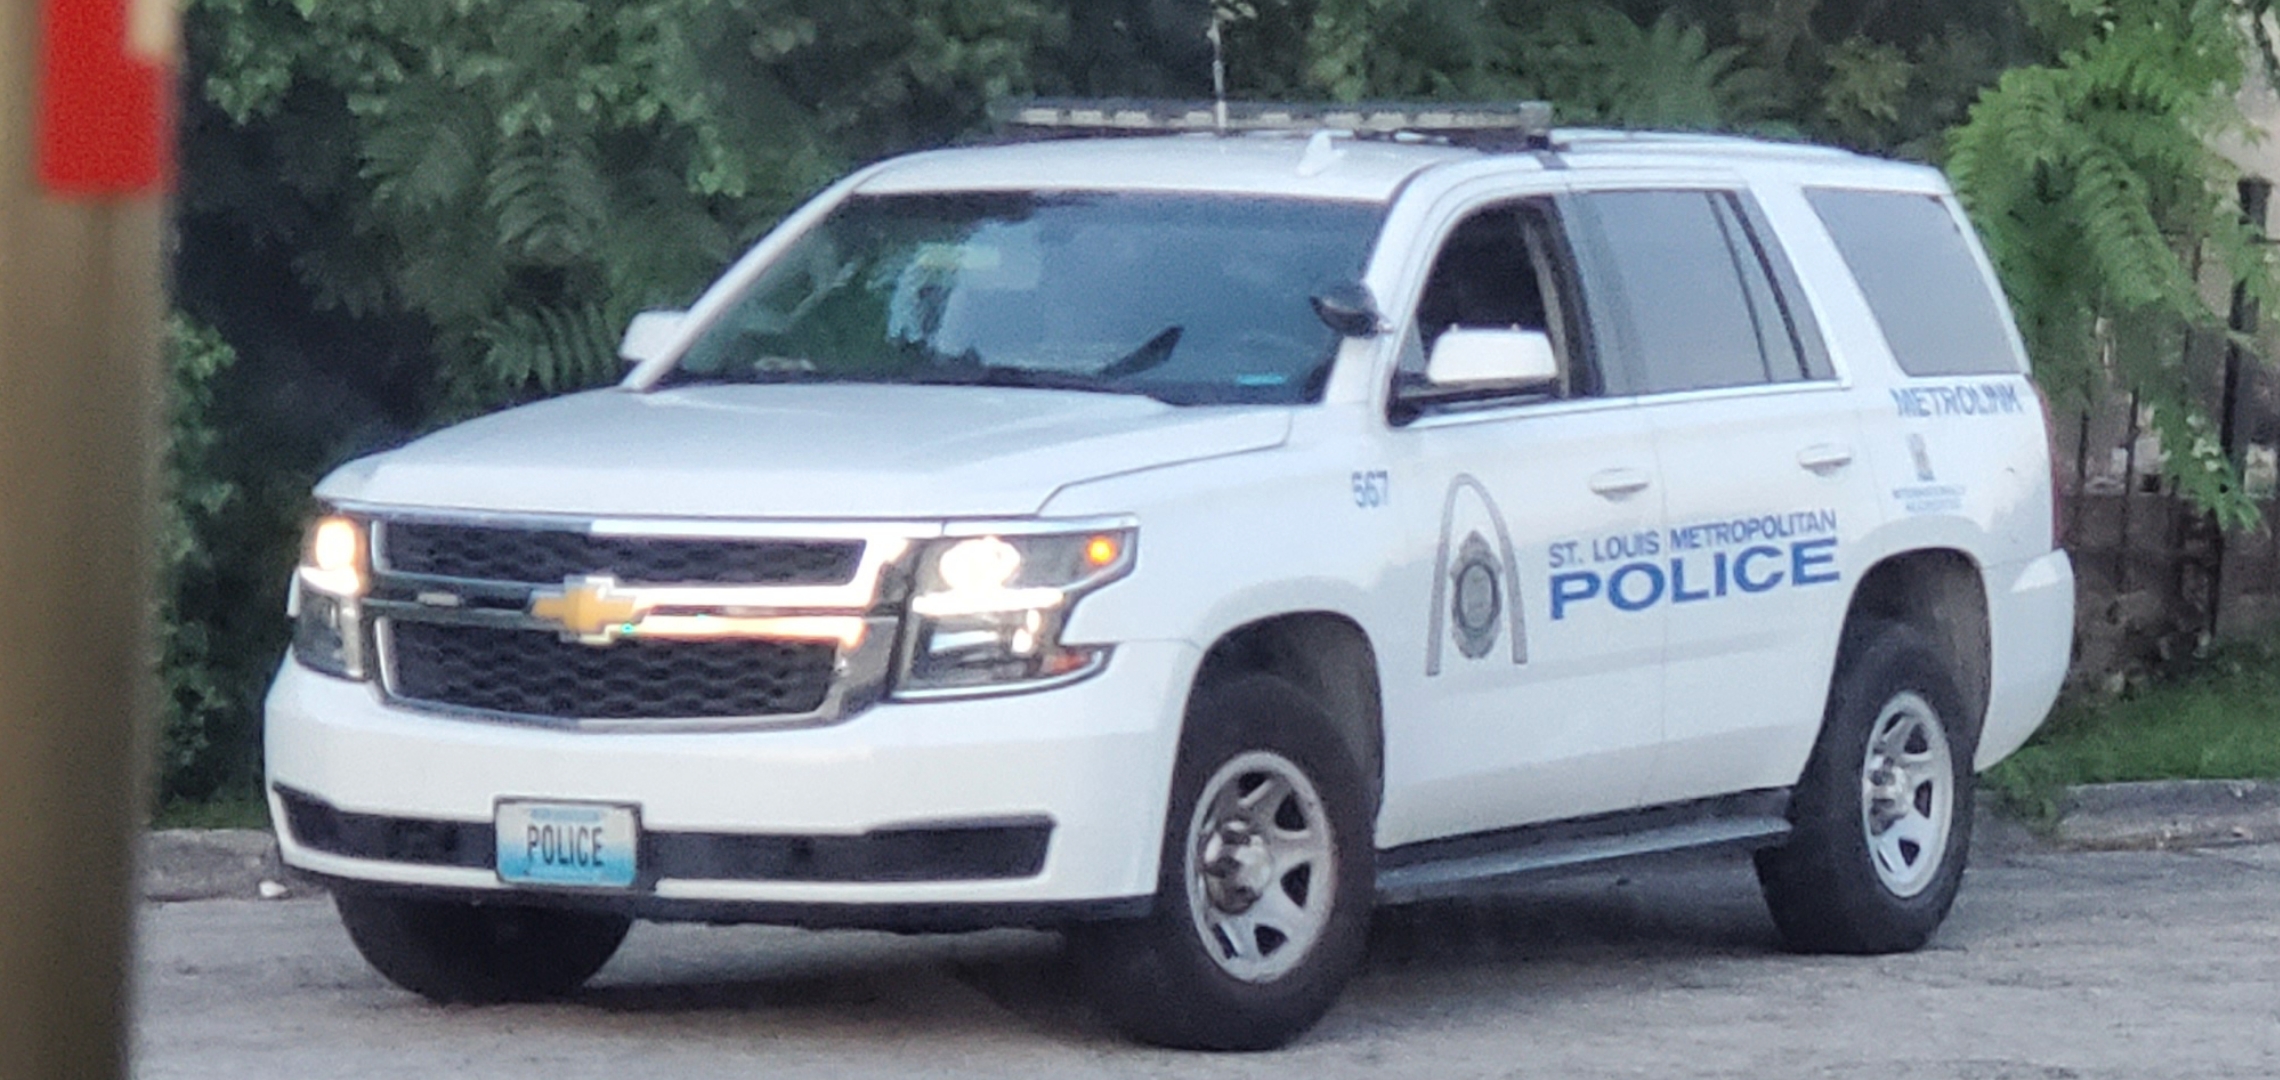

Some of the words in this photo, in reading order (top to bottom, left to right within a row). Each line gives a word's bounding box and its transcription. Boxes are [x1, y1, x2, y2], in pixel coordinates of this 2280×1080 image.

[1889, 384, 2023, 417] METROLINK
[1351, 470, 1388, 508] 567
[1549, 541, 1584, 568] ST.
[1593, 530, 1660, 562] LOUIS
[1669, 509, 1837, 550] METROPOLITAN
[1549, 536, 1840, 620] POLICE
[527, 825, 604, 867] POLICE
